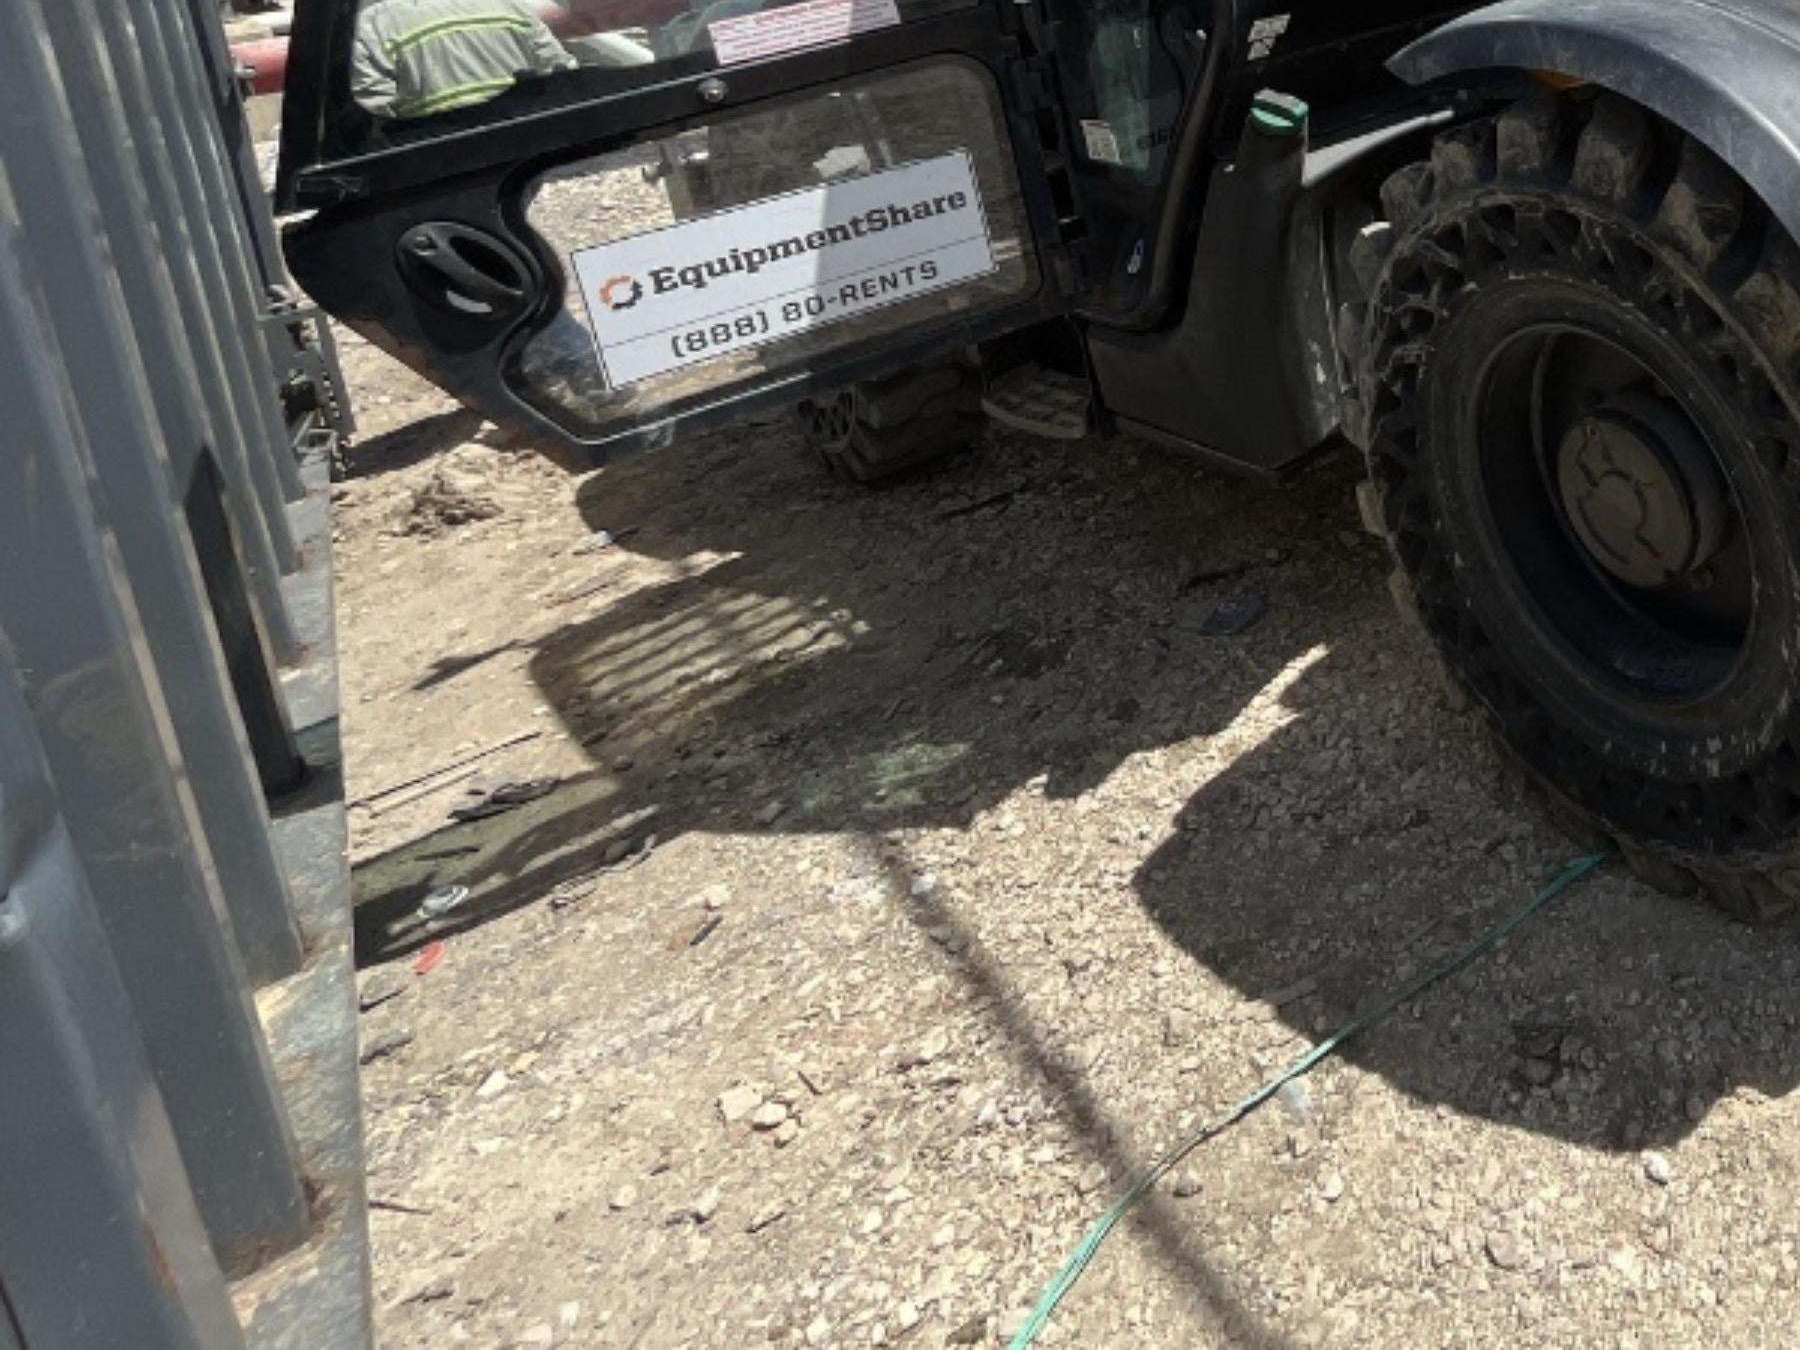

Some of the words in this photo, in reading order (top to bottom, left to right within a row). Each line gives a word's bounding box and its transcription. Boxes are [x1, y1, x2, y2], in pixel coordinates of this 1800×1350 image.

[649, 191, 967, 295] EquipmentShare
[671, 311, 769, 358] (888)
[782, 260, 938, 324] 80-RENTS
